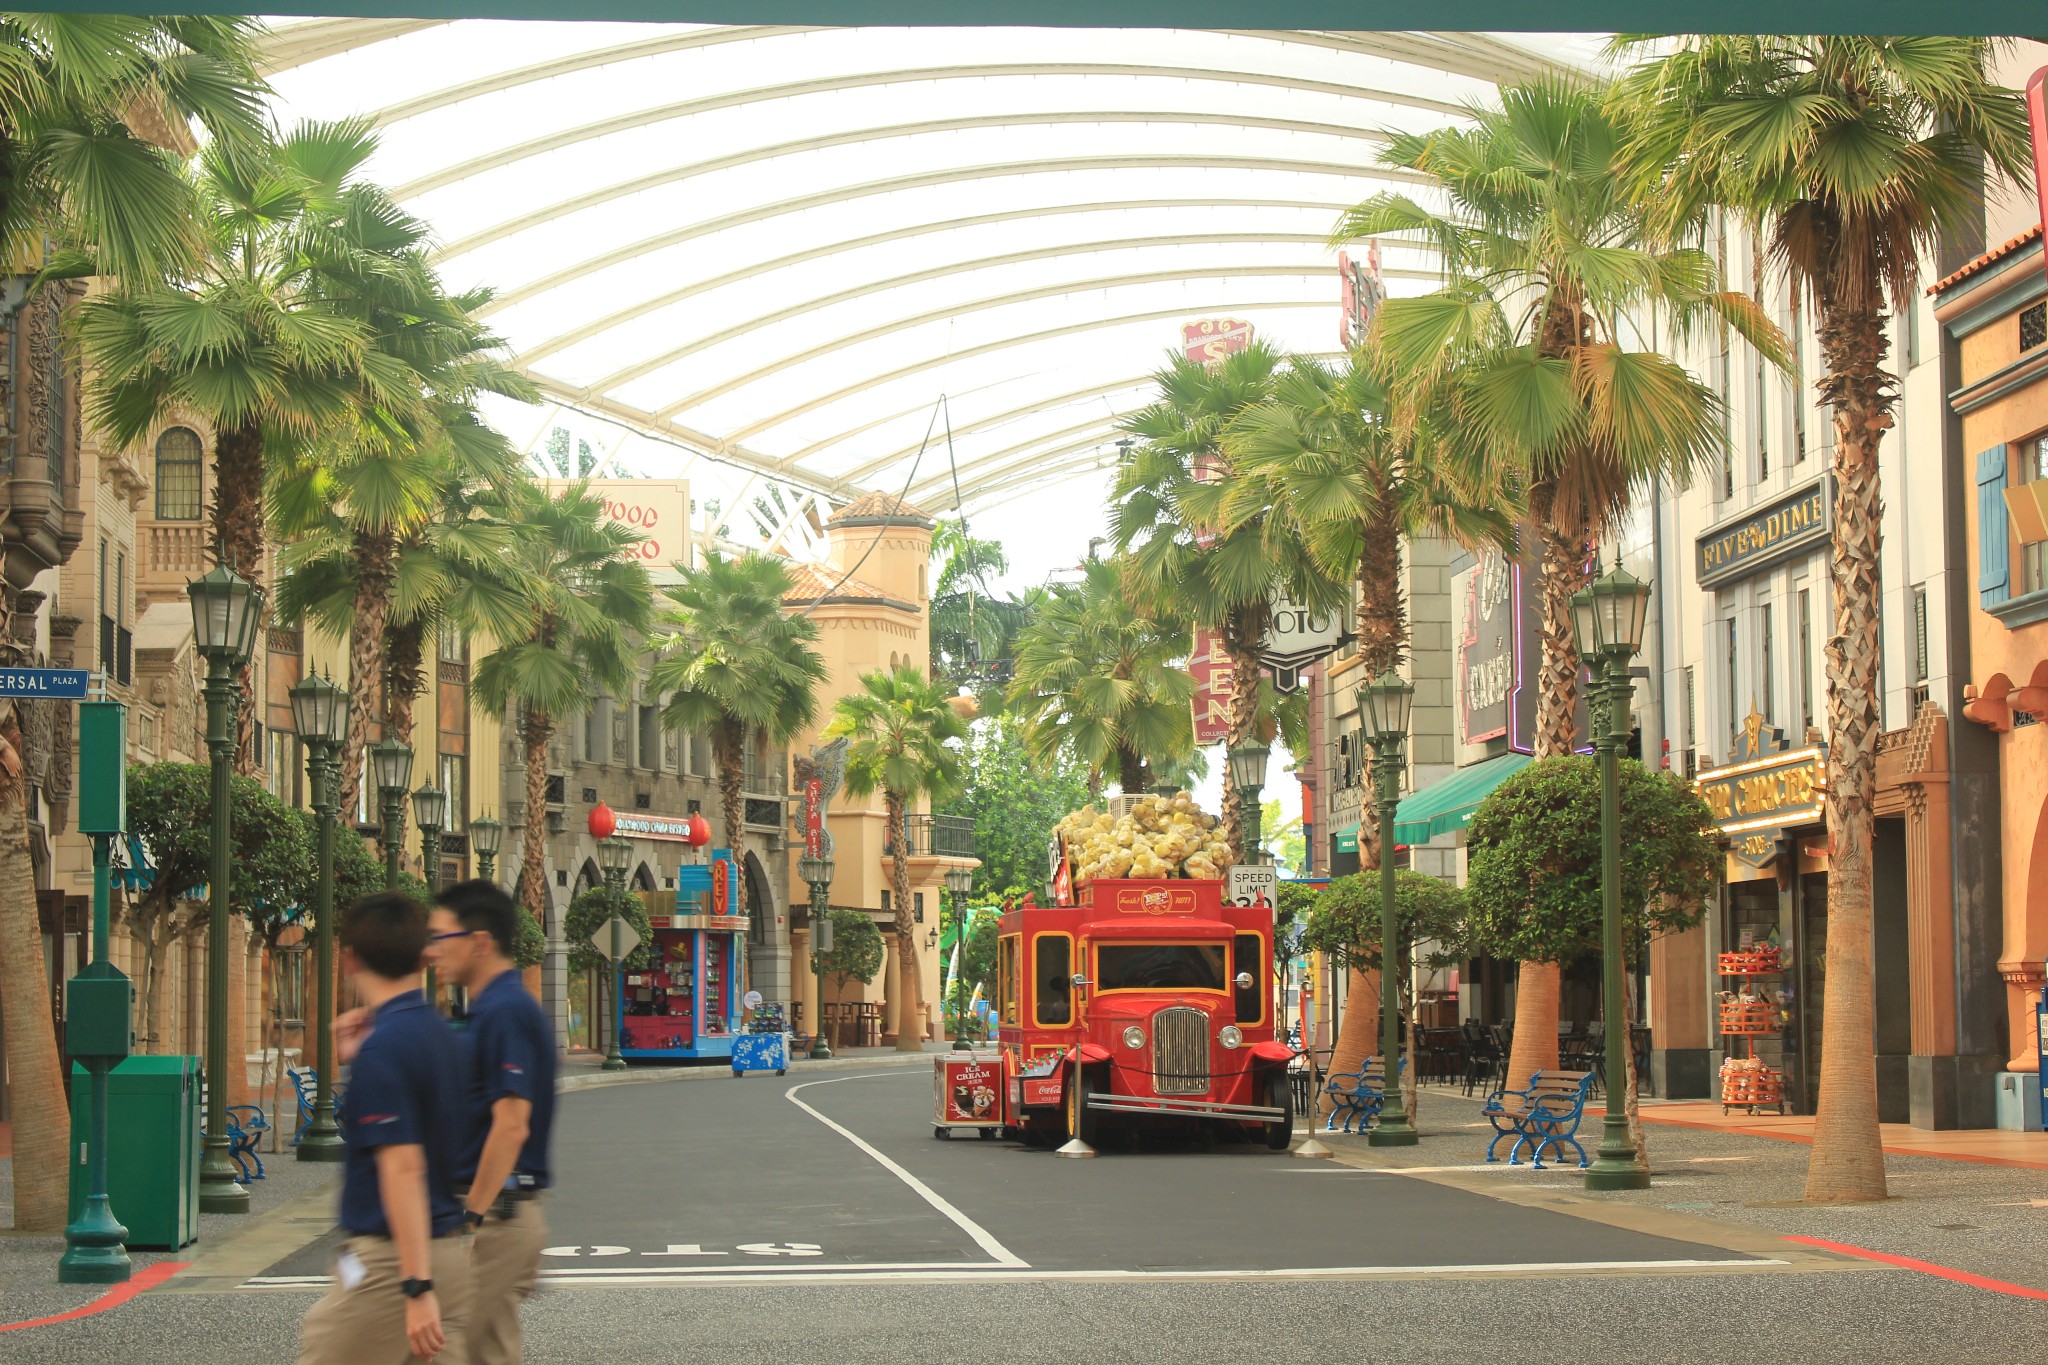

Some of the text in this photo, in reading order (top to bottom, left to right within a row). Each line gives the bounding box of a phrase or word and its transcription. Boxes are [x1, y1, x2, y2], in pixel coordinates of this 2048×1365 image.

[1704, 531, 1749, 571] FIVE
[1767, 494, 1822, 543] DIME
[53, 677, 78, 685] PLAZA
[1735, 765, 1814, 816] CHARACTERS
[810, 782, 818, 819] CHINA
[810, 829, 818, 857] BIST
[1235, 873, 1272, 883] SPEED
[1240, 885, 1267, 894] LIMIT
[956, 1071, 990, 1081] CREAM
